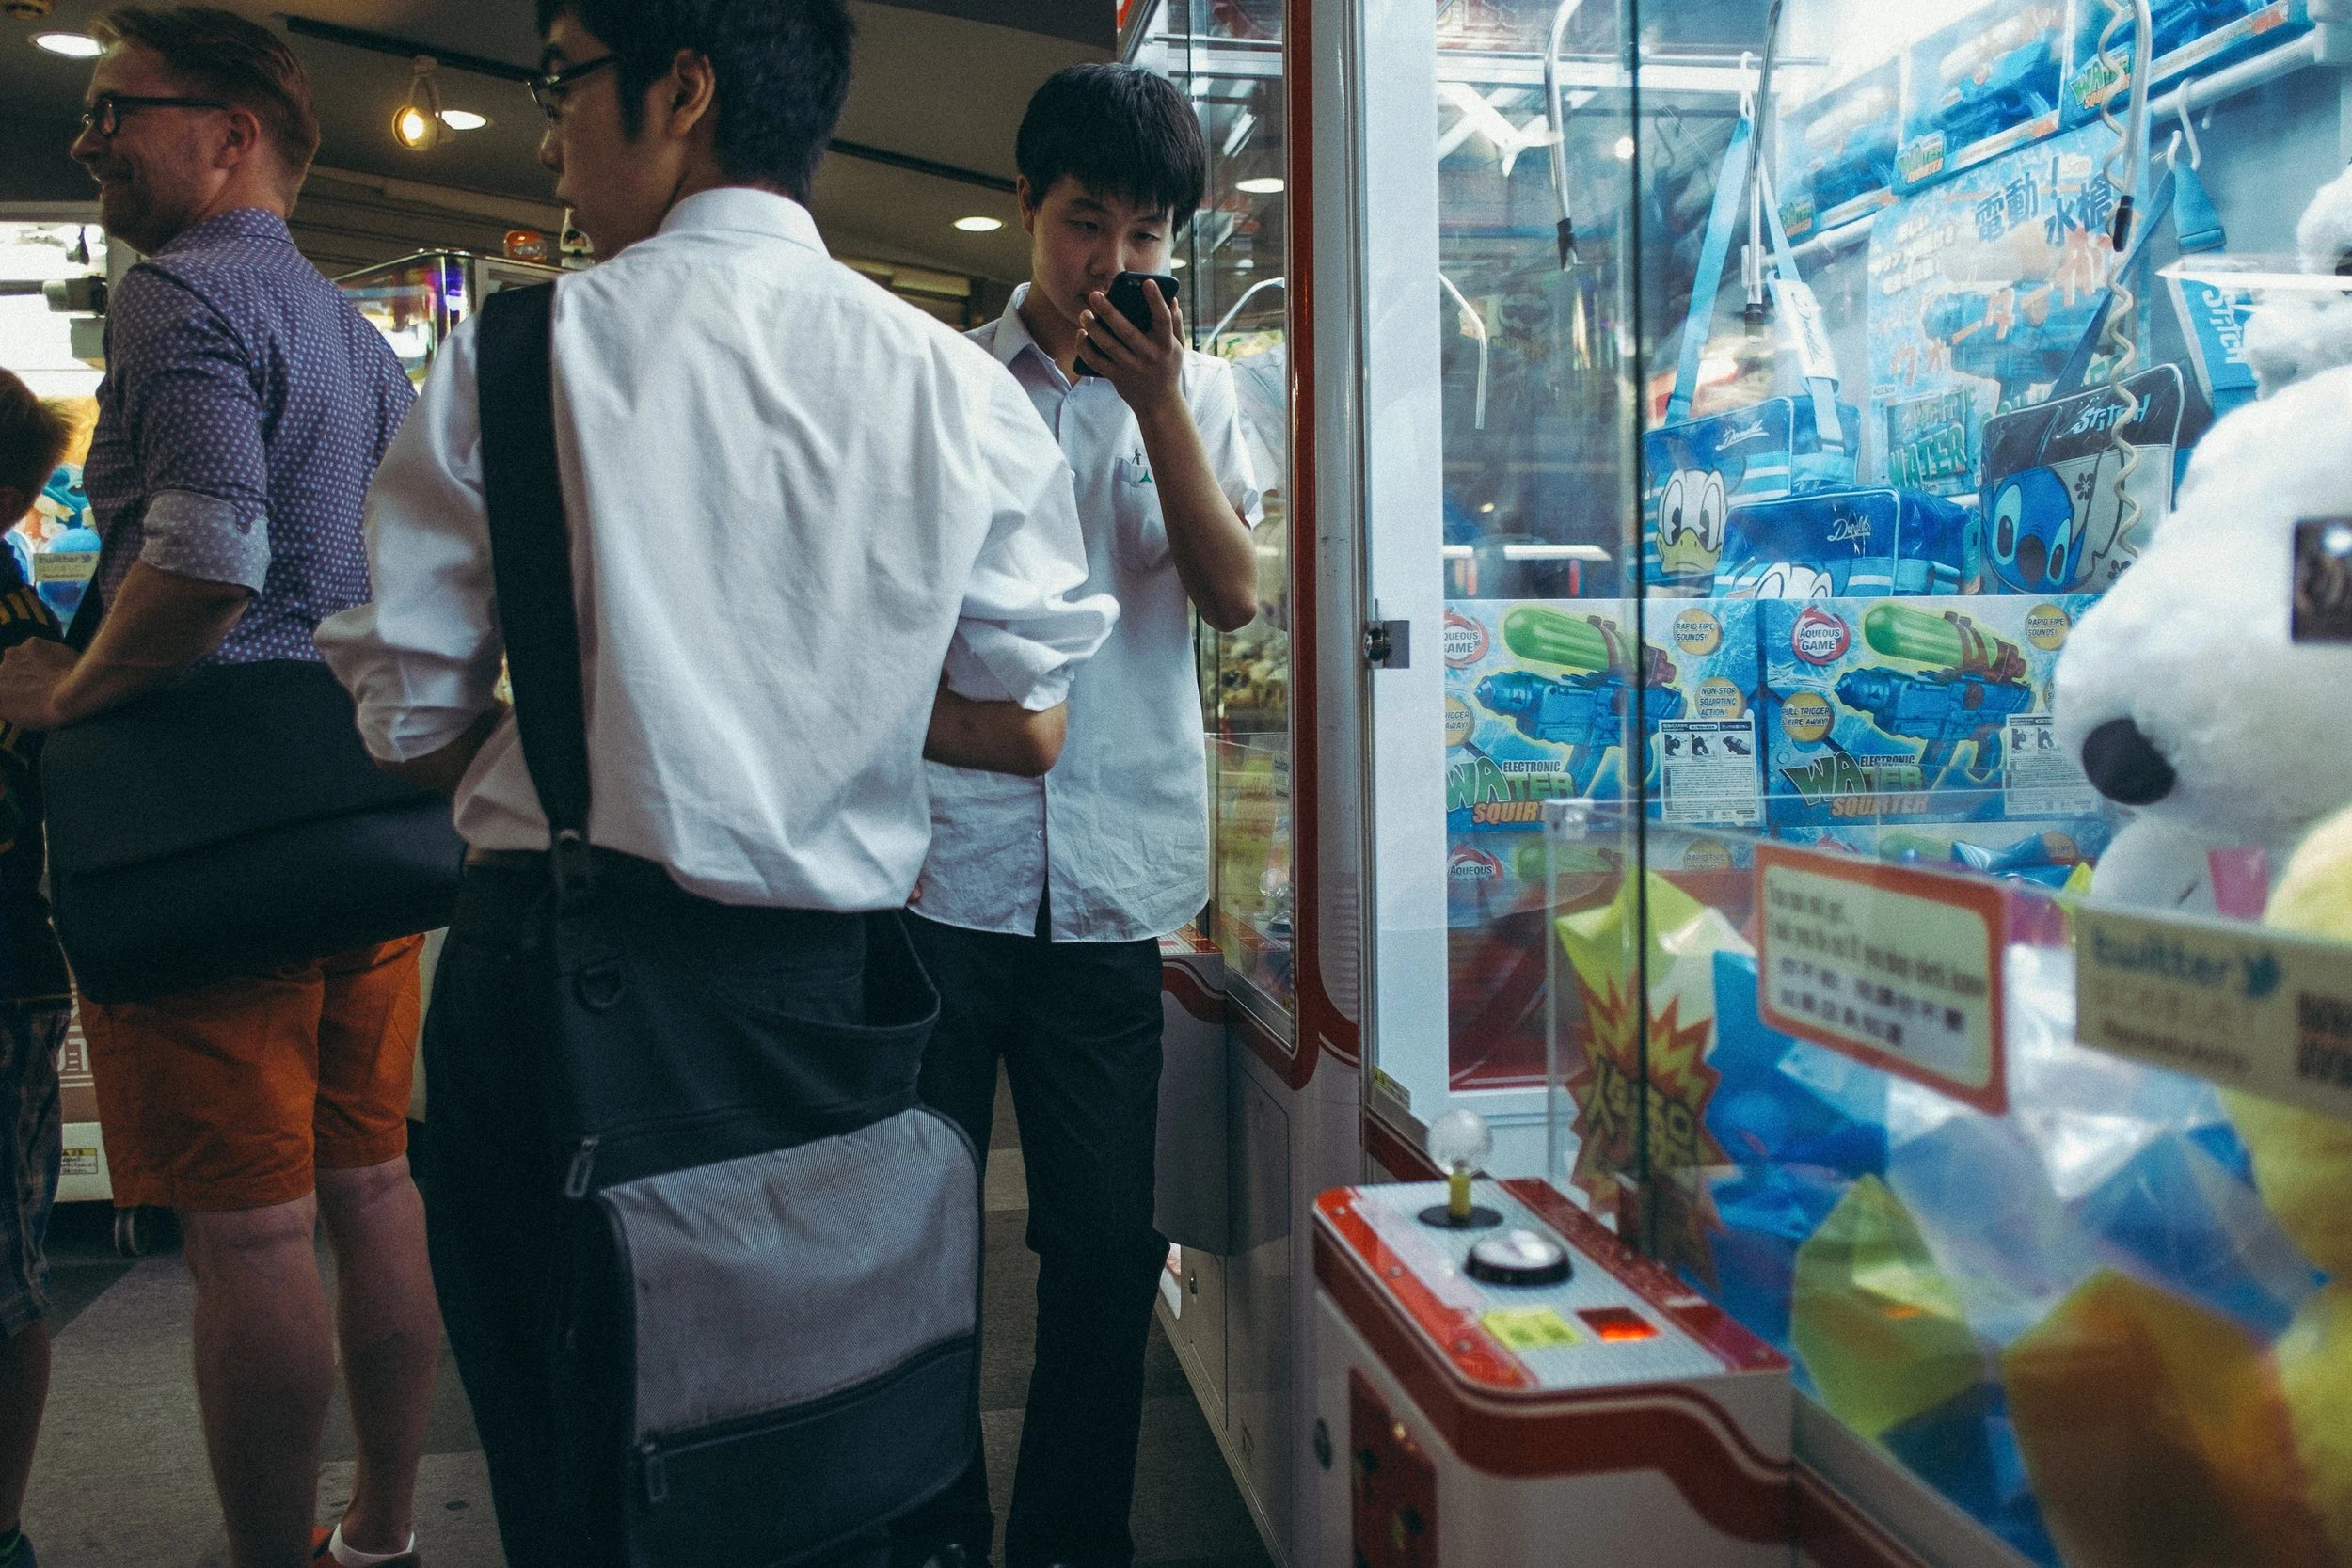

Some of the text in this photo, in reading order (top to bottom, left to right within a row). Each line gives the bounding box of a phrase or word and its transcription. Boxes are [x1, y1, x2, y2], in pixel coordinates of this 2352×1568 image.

[1676, 622, 1714, 630] RAPID FIRE
[2049, 617, 2065, 626] FIRE
[1444, 631, 1479, 641] QUEOUS
[1799, 627, 1840, 638] AQUEOUS
[1801, 640, 1836, 651] GAME
[1701, 687, 1737, 695] NON-STOP
[1699, 697, 1737, 706] SQUIRTING
[1800, 707, 1830, 716] TRIGGER
[1788, 718, 1804, 726] FIRE
[1502, 761, 1561, 772] ELECTRONIC
[1860, 755, 1915, 767] ELECTRONIC
[1446, 756, 1575, 813] WATER
[1779, 752, 1924, 806] WATER
[1831, 796, 1928, 817] SQUIRTER
[1450, 865, 1492, 876] AQUEOUS
